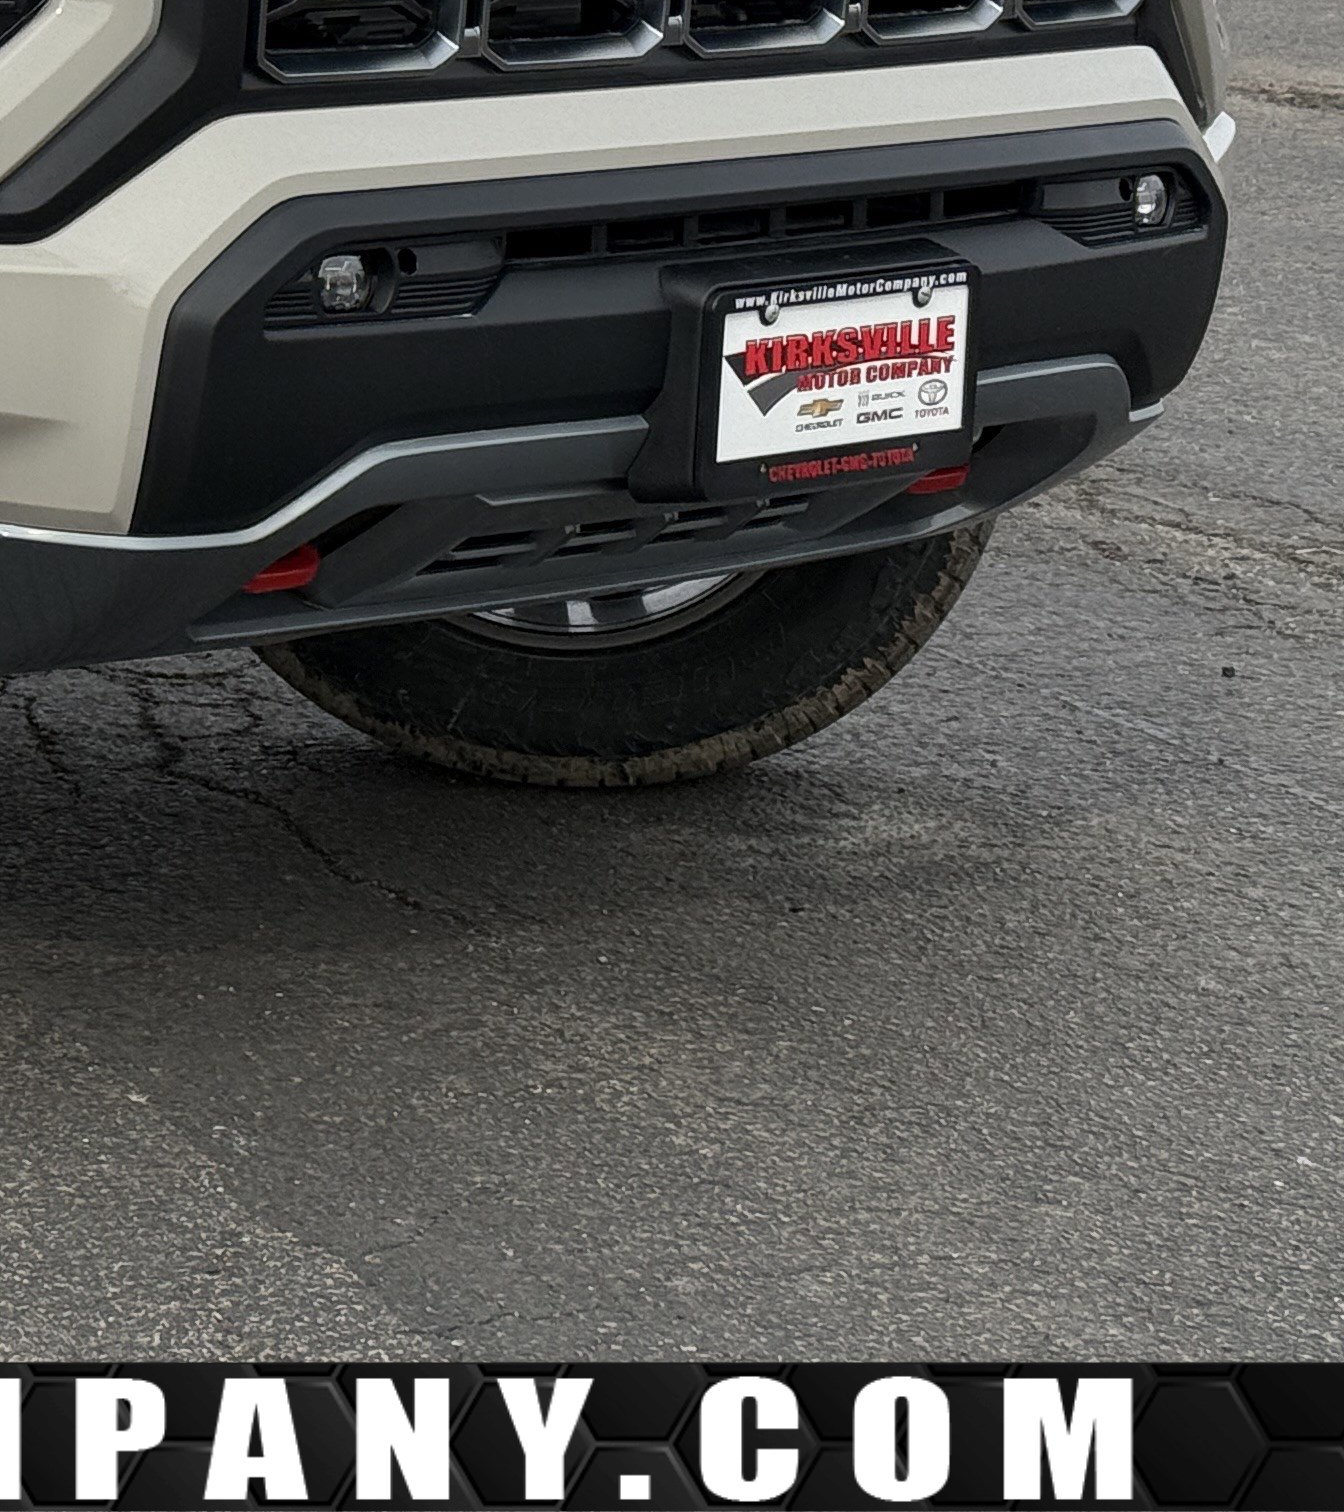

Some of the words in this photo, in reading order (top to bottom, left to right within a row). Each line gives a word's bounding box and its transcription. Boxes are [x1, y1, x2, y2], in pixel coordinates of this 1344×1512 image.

[734, 271, 968, 309] www.KirksvilleMotorCompany.com
[744, 315, 956, 376] KIRKSVILLE
[796, 369, 861, 393] MOTOR
[865, 356, 954, 383] COMPANY
[871, 389, 906, 402] BUICK
[795, 418, 844, 433] CHEVROLET
[856, 407, 904, 424] GMC
[914, 406, 950, 419] TOYOTA
